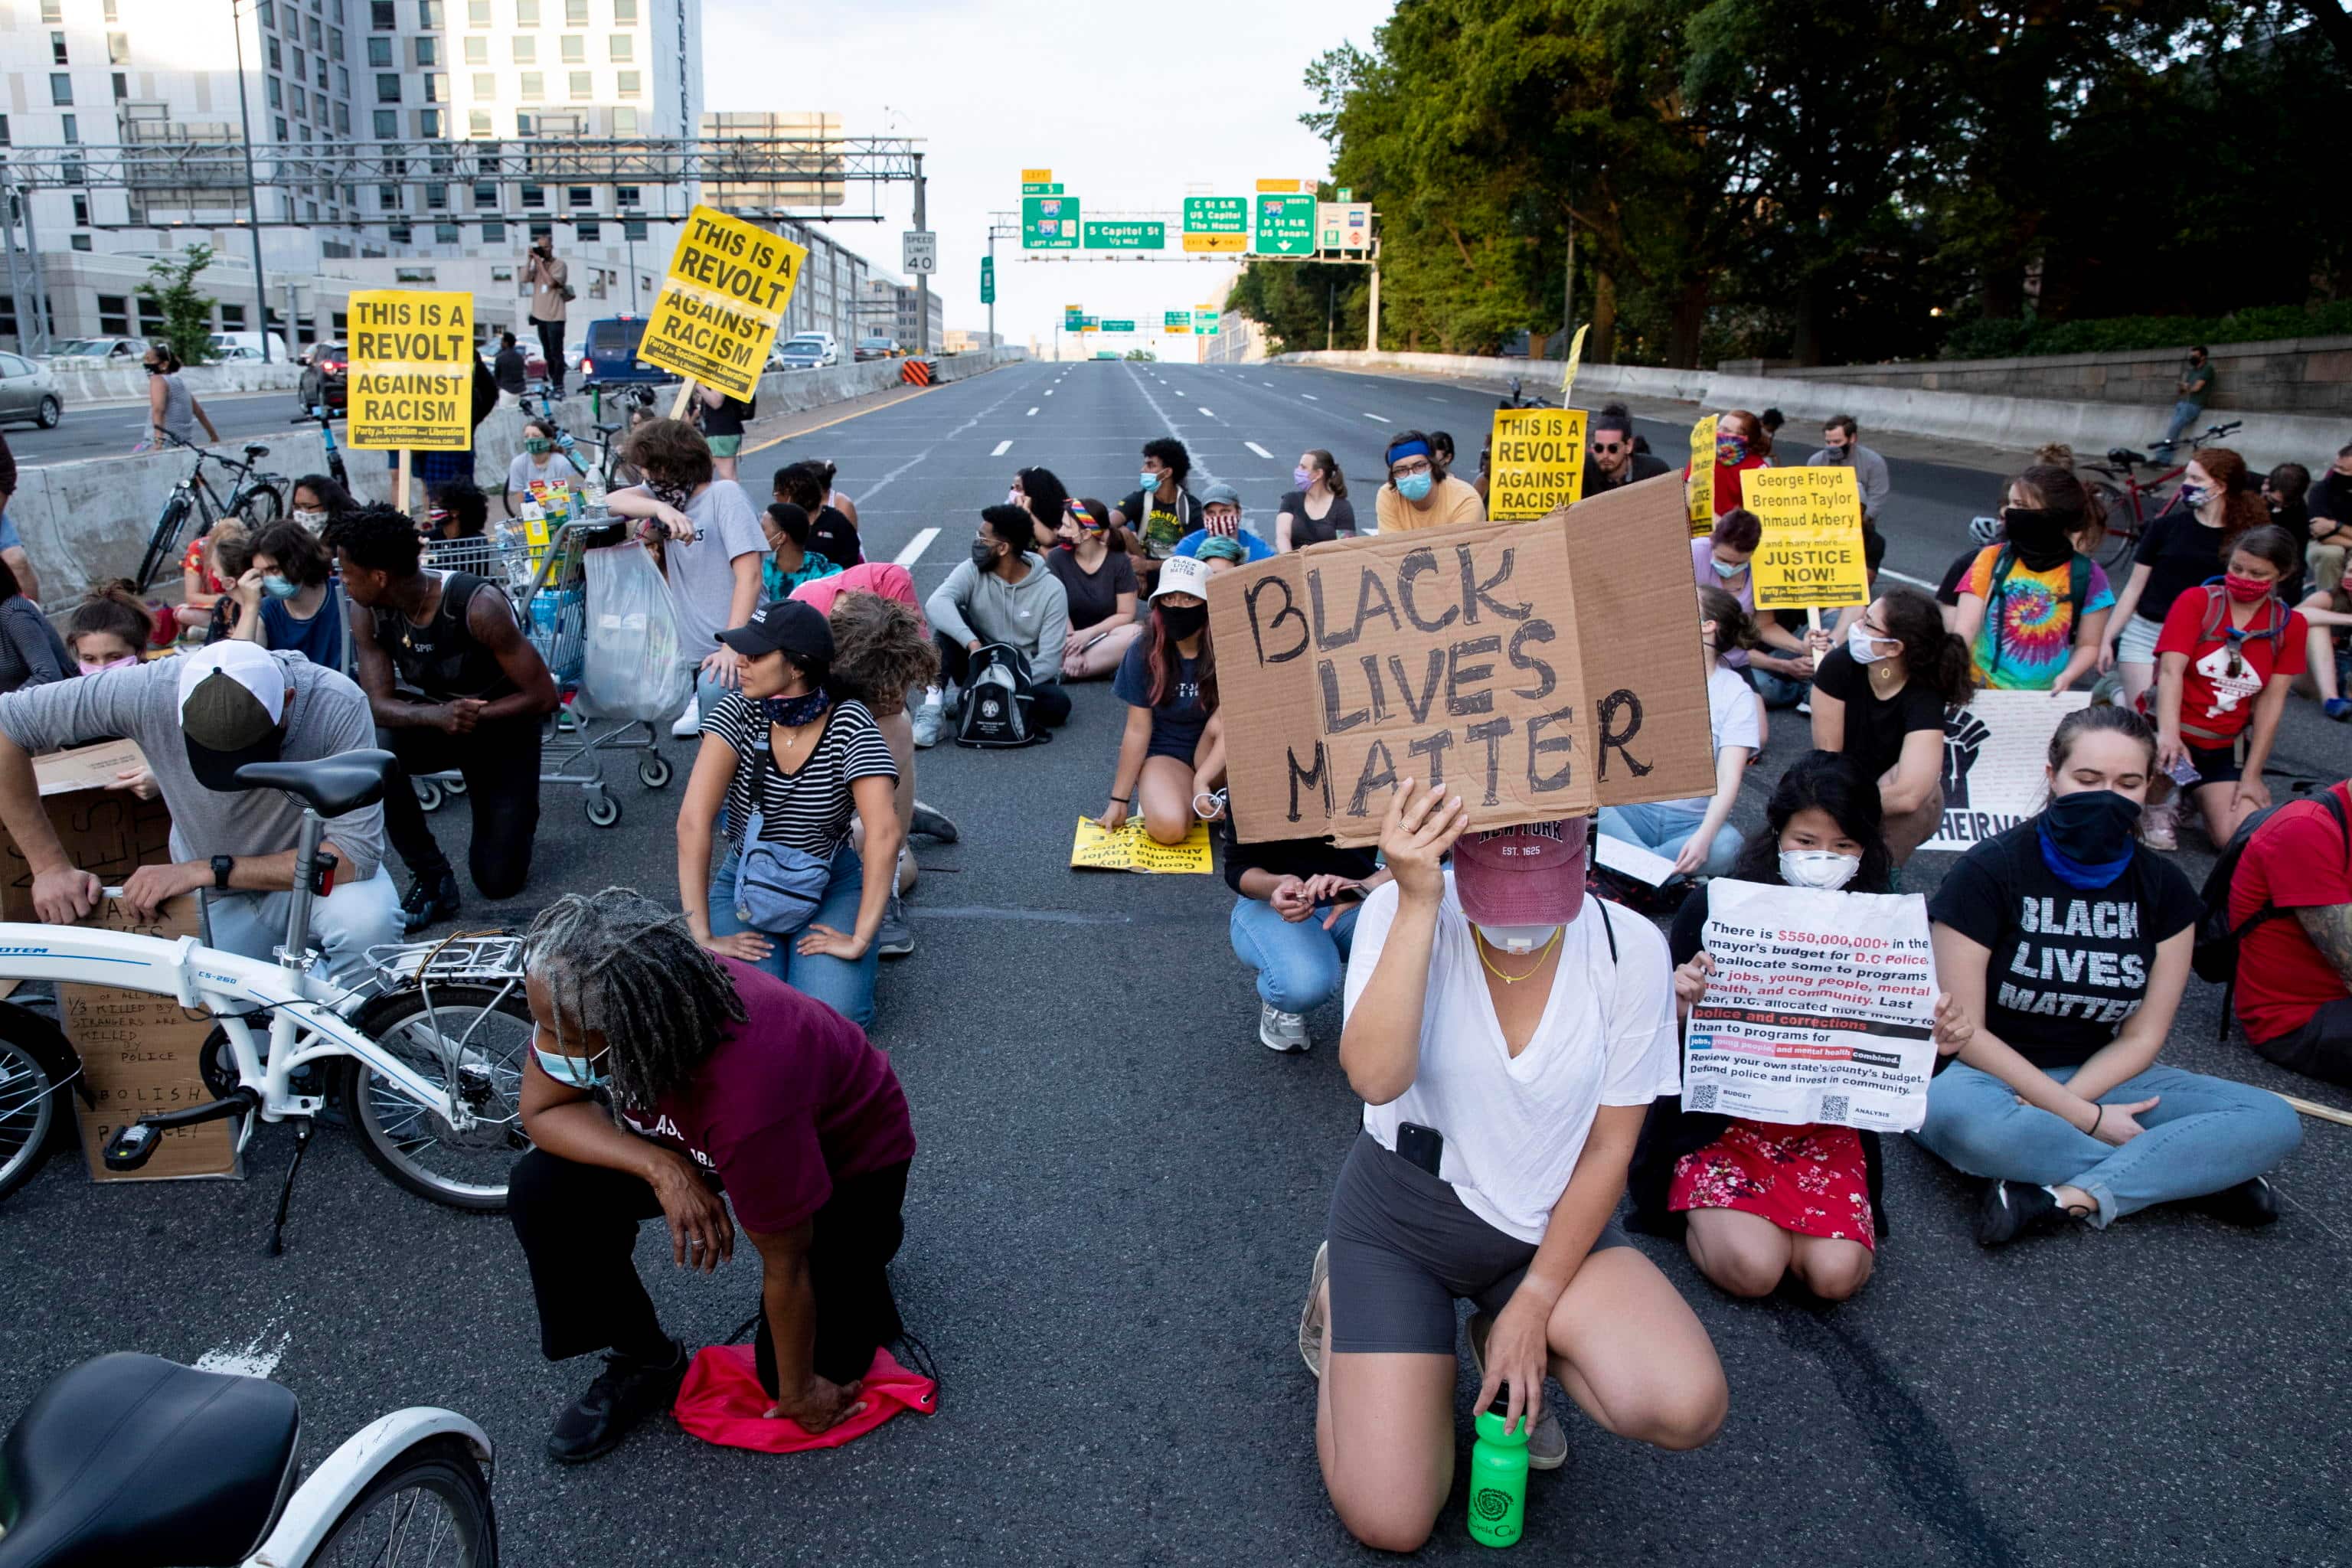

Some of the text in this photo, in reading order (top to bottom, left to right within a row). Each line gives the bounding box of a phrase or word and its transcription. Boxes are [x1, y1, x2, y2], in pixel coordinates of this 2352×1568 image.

[1194, 201, 1200, 209] C
[1205, 201, 1215, 209] St
[1264, 204, 1284, 214] 395
[1190, 211, 1241, 220] US Capitol
[1264, 219, 1270, 227] D
[1275, 219, 1285, 227] St
[1089, 226, 1159, 237] S Capitol St
[1191, 221, 1240, 230] The House
[1260, 229, 1310, 237] US Senate
[694, 218, 791, 278] THIS IS A
[908, 257, 932, 270] 40
[678, 247, 786, 309] REVOLT
[356, 302, 466, 328] THIS IS A
[665, 289, 770, 344] AGAINST
[358, 332, 464, 361] REVOLT
[662, 315, 753, 368] RACISM
[648, 337, 666, 353] Party
[675, 348, 707, 367] Socialism
[719, 365, 751, 384] Liberation
[357, 373, 464, 395] AGAINST
[365, 400, 456, 422] RACISM
[355, 426, 375, 436] Party
[384, 427, 417, 436] Socialism
[1500, 420, 1579, 436] THIS IS A
[1498, 442, 1578, 463] REVOLT
[1497, 472, 1576, 488] AGAINST
[1757, 472, 1843, 489] George Floyd
[1502, 492, 1570, 508] RACISM
[1753, 492, 1852, 508] Breonna Taylor
[1762, 513, 1854, 528] hmaud Arbery
[1766, 540, 1811, 549] and many
[1173, 558, 1197, 567] BLACK
[1764, 550, 1852, 566] JUSTICE
[1170, 568, 1195, 577] MATTER
[1783, 567, 1835, 583] NOW!
[1245, 542, 1533, 668] BLACK
[1318, 619, 1556, 735] LIVES
[1287, 689, 1654, 823] MATTER
[1521, 820, 1563, 843] YORK
[1081, 850, 1202, 861] Breonna Taylor
[1140, 843, 1202, 854] Ahmaud
[1502, 845, 1541, 856] EST. 1625
[1138, 859, 1195, 870] George
[2020, 897, 2139, 939] BLACK
[1711, 921, 1929, 949] There is $550,000,000+ in the
[1709, 939, 1929, 965] mayor's budget for D.C Police,
[1791, 963, 1832, 972] some
[1837, 964, 1852, 974] to
[1856, 969, 1928, 982] programs
[2010, 941, 2146, 988] LIVES
[198, 971, 237, 985] CS-260
[1727, 970, 1930, 996] jobs, young people, mental
[1758, 986, 1913, 1009] and community. Last
[96, 1004, 145, 1014] KILLED
[156, 1004, 175, 1013] BY
[1733, 997, 1936, 1026] D.C. allocated more money to
[73, 1018, 144, 1028] STRANGERS
[1694, 1008, 1868, 1031] police and corrections
[81, 1031, 137, 1042] KILLED
[1693, 1023, 1831, 1042] than to programs for
[123, 1041, 142, 1050] BY
[1690, 1037, 1710, 1046] jobs,
[1713, 1038, 1739, 1047] young
[1741, 1043, 1775, 1054] people,
[1853, 1051, 1900, 1064] combined.
[122, 1053, 178, 1061] POLICE
[1690, 1054, 1925, 1084] Review your own state's/county's budget.
[1690, 1065, 1727, 1074] Defund
[1730, 1068, 1767, 1080] police
[1771, 1074, 1792, 1083] and
[1795, 1075, 1827, 1084] invest
[1842, 1078, 1910, 1096] community.
[1723, 1089, 1752, 1099] BUDGET
[1855, 1108, 1890, 1118] ANALYSIS
